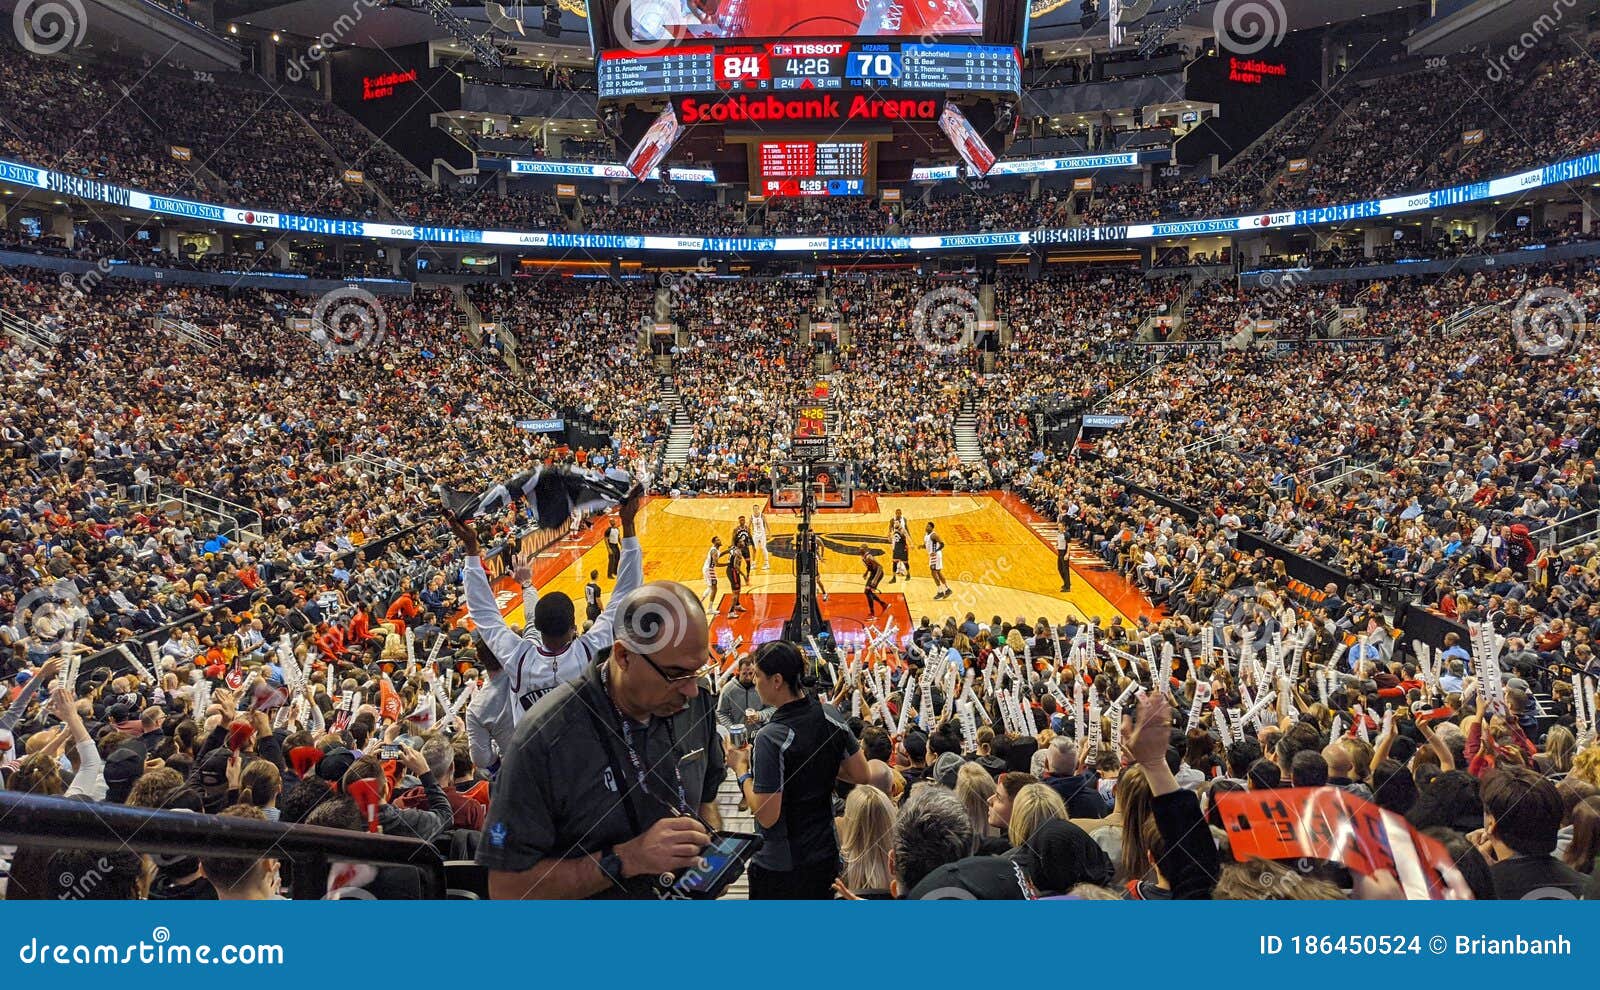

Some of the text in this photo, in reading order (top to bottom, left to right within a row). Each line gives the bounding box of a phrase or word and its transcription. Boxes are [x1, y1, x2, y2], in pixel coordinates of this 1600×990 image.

[793, 44, 842, 54] TISSOT
[723, 57, 760, 78] 84
[786, 58, 830, 75] 4:26
[857, 54, 892, 75] 70
[1425, 56, 1448, 68] 306
[781, 80, 794, 88] 24
[818, 79, 824, 88] 3
[681, 95, 936, 122] Scotiabank Arena
[1059, 155, 1129, 168] TORONTO STAR
[520, 163, 629, 177] TORONTO STAR Coors
[800, 181, 821, 190] 4:26
[9, 166, 35, 182] STAR
[46, 172, 106, 200] SUBSCRIBE
[108, 186, 130, 206] NOW
[154, 198, 198, 215] TORONTO
[199, 206, 221, 219] STAR
[278, 214, 364, 236] REPORTERS
[391, 228, 413, 236] DOUG
[413, 226, 462, 242] SMITH
[520, 236, 545, 244] LAURA
[547, 234, 623, 248] ARMSTRONG
[702, 238, 759, 251] ARTHUR
[828, 237, 894, 250] FESCHUK
[944, 236, 989, 246] TORONTO
[990, 234, 1016, 245] STAR
[1028, 227, 1095, 244] SUBSCRIBE
[1100, 226, 1128, 240] NOW
[1156, 221, 1207, 235] TORONTO
[1208, 219, 1238, 230] STAR
[1295, 201, 1381, 225] REPORTERS
[1408, 197, 1429, 207] DOUG
[1429, 185, 1471, 208] SMITH
[1521, 174, 1540, 186] LAURA
[1541, 154, 1600, 185] ARMSTRON
[802, 408, 824, 419] 4:26
